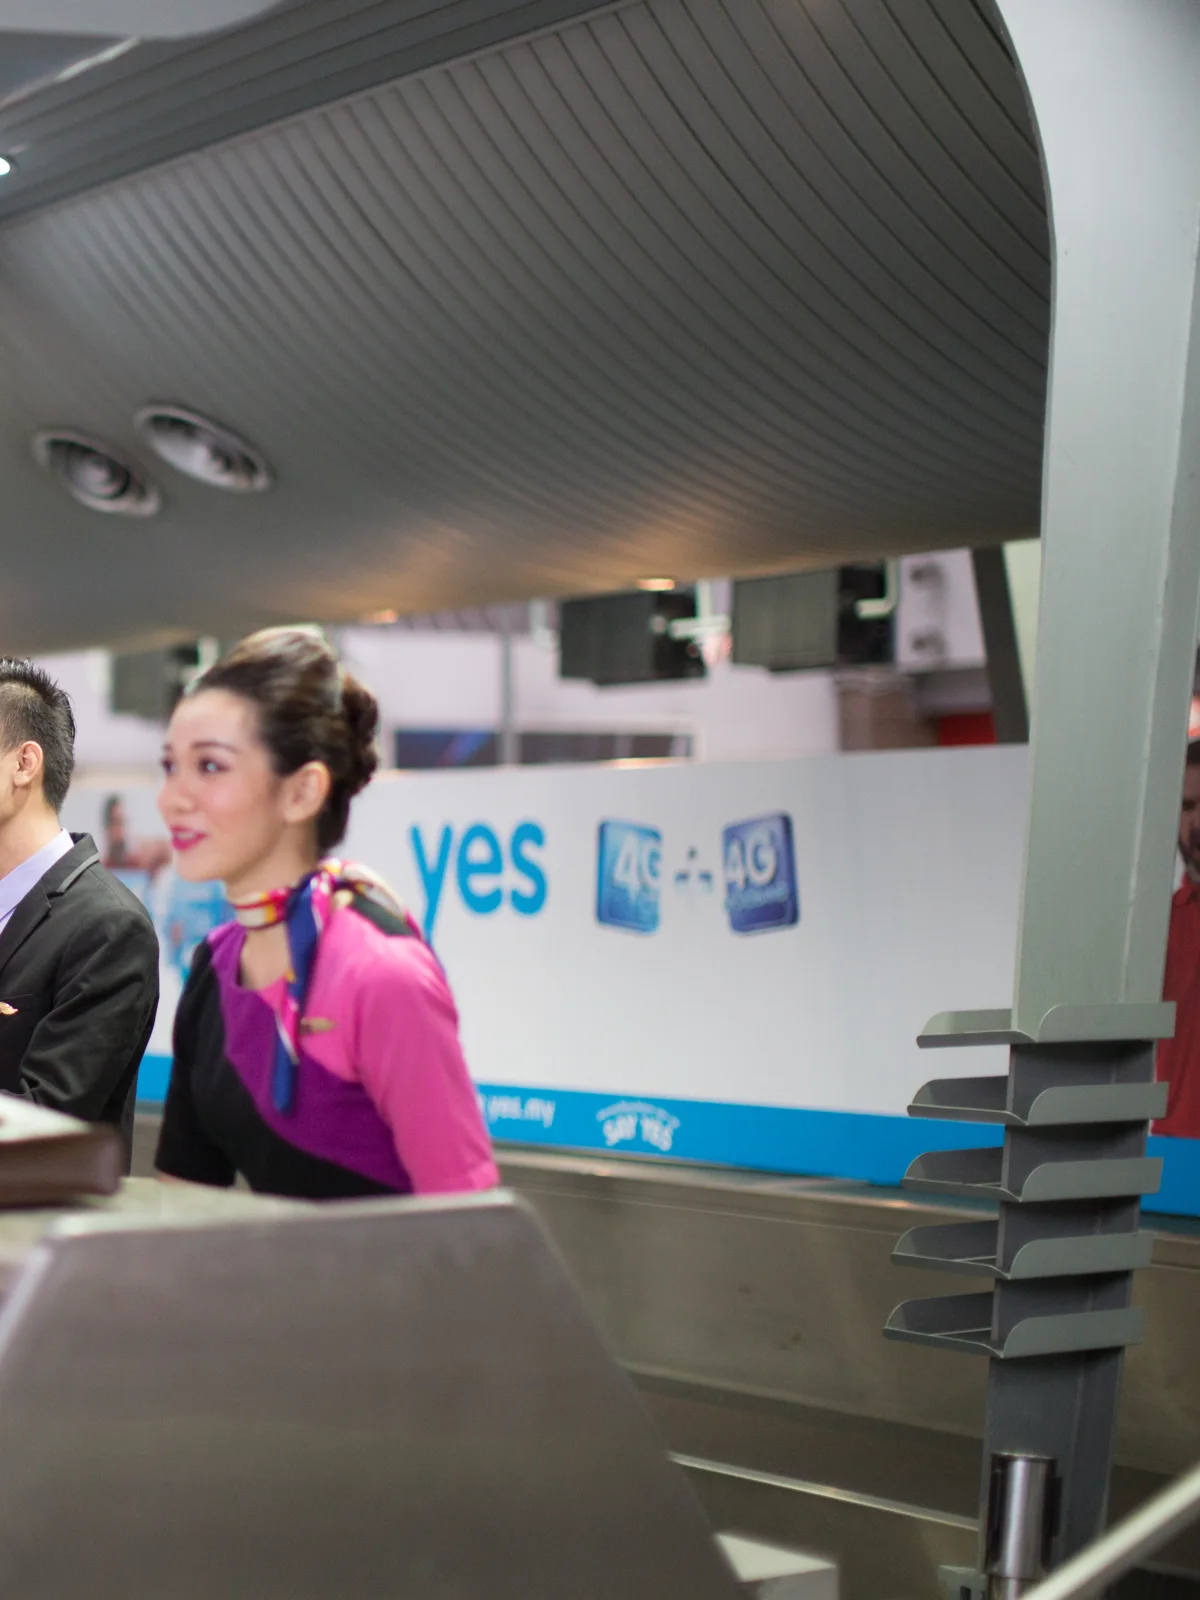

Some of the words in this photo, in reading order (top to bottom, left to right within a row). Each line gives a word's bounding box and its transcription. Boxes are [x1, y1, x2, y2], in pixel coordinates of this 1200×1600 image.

[410, 823, 547, 945] yes
[612, 831, 661, 902] 4G
[724, 825, 776, 888] 4G
